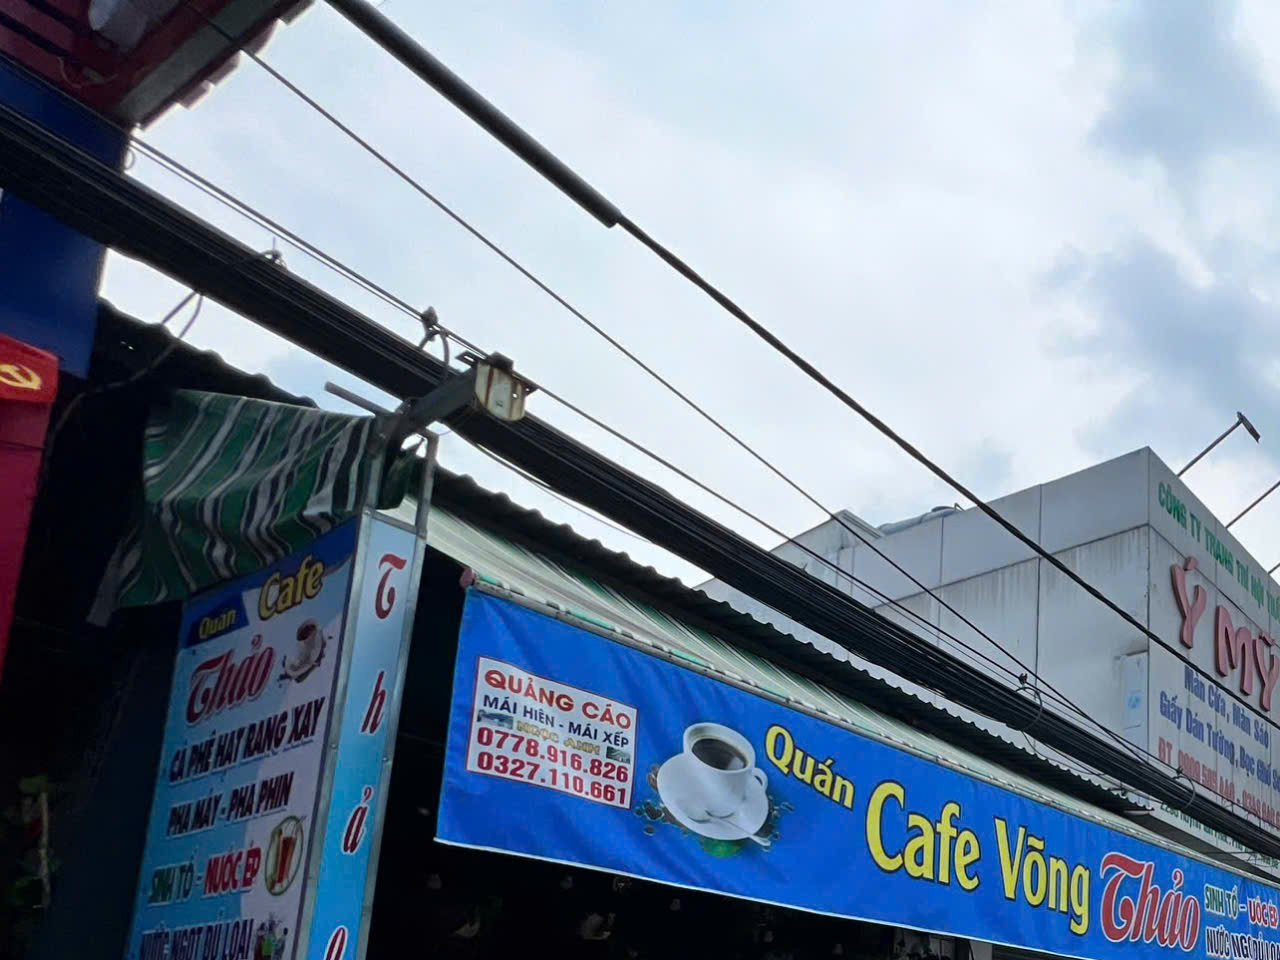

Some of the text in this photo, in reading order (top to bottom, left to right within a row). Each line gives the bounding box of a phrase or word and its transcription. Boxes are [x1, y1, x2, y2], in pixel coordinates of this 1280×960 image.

[258, 554, 325, 621] Cafe
[287, 696, 325, 745] XAY
[483, 695, 517, 714] MÁI
[523, 702, 555, 728] HIÊN
[568, 721, 597, 740] MÁI
[484, 669, 631, 730] QUẢNG CÁO
[477, 726, 629, 783] 0778.916.826
[477, 751, 627, 806] 0327.110.661
[255, 771, 294, 815] PHIN
[764, 725, 855, 809] Quán
[865, 782, 980, 892] Cafe
[995, 817, 1090, 936] Võng
[1099, 851, 1200, 953] Thảo
